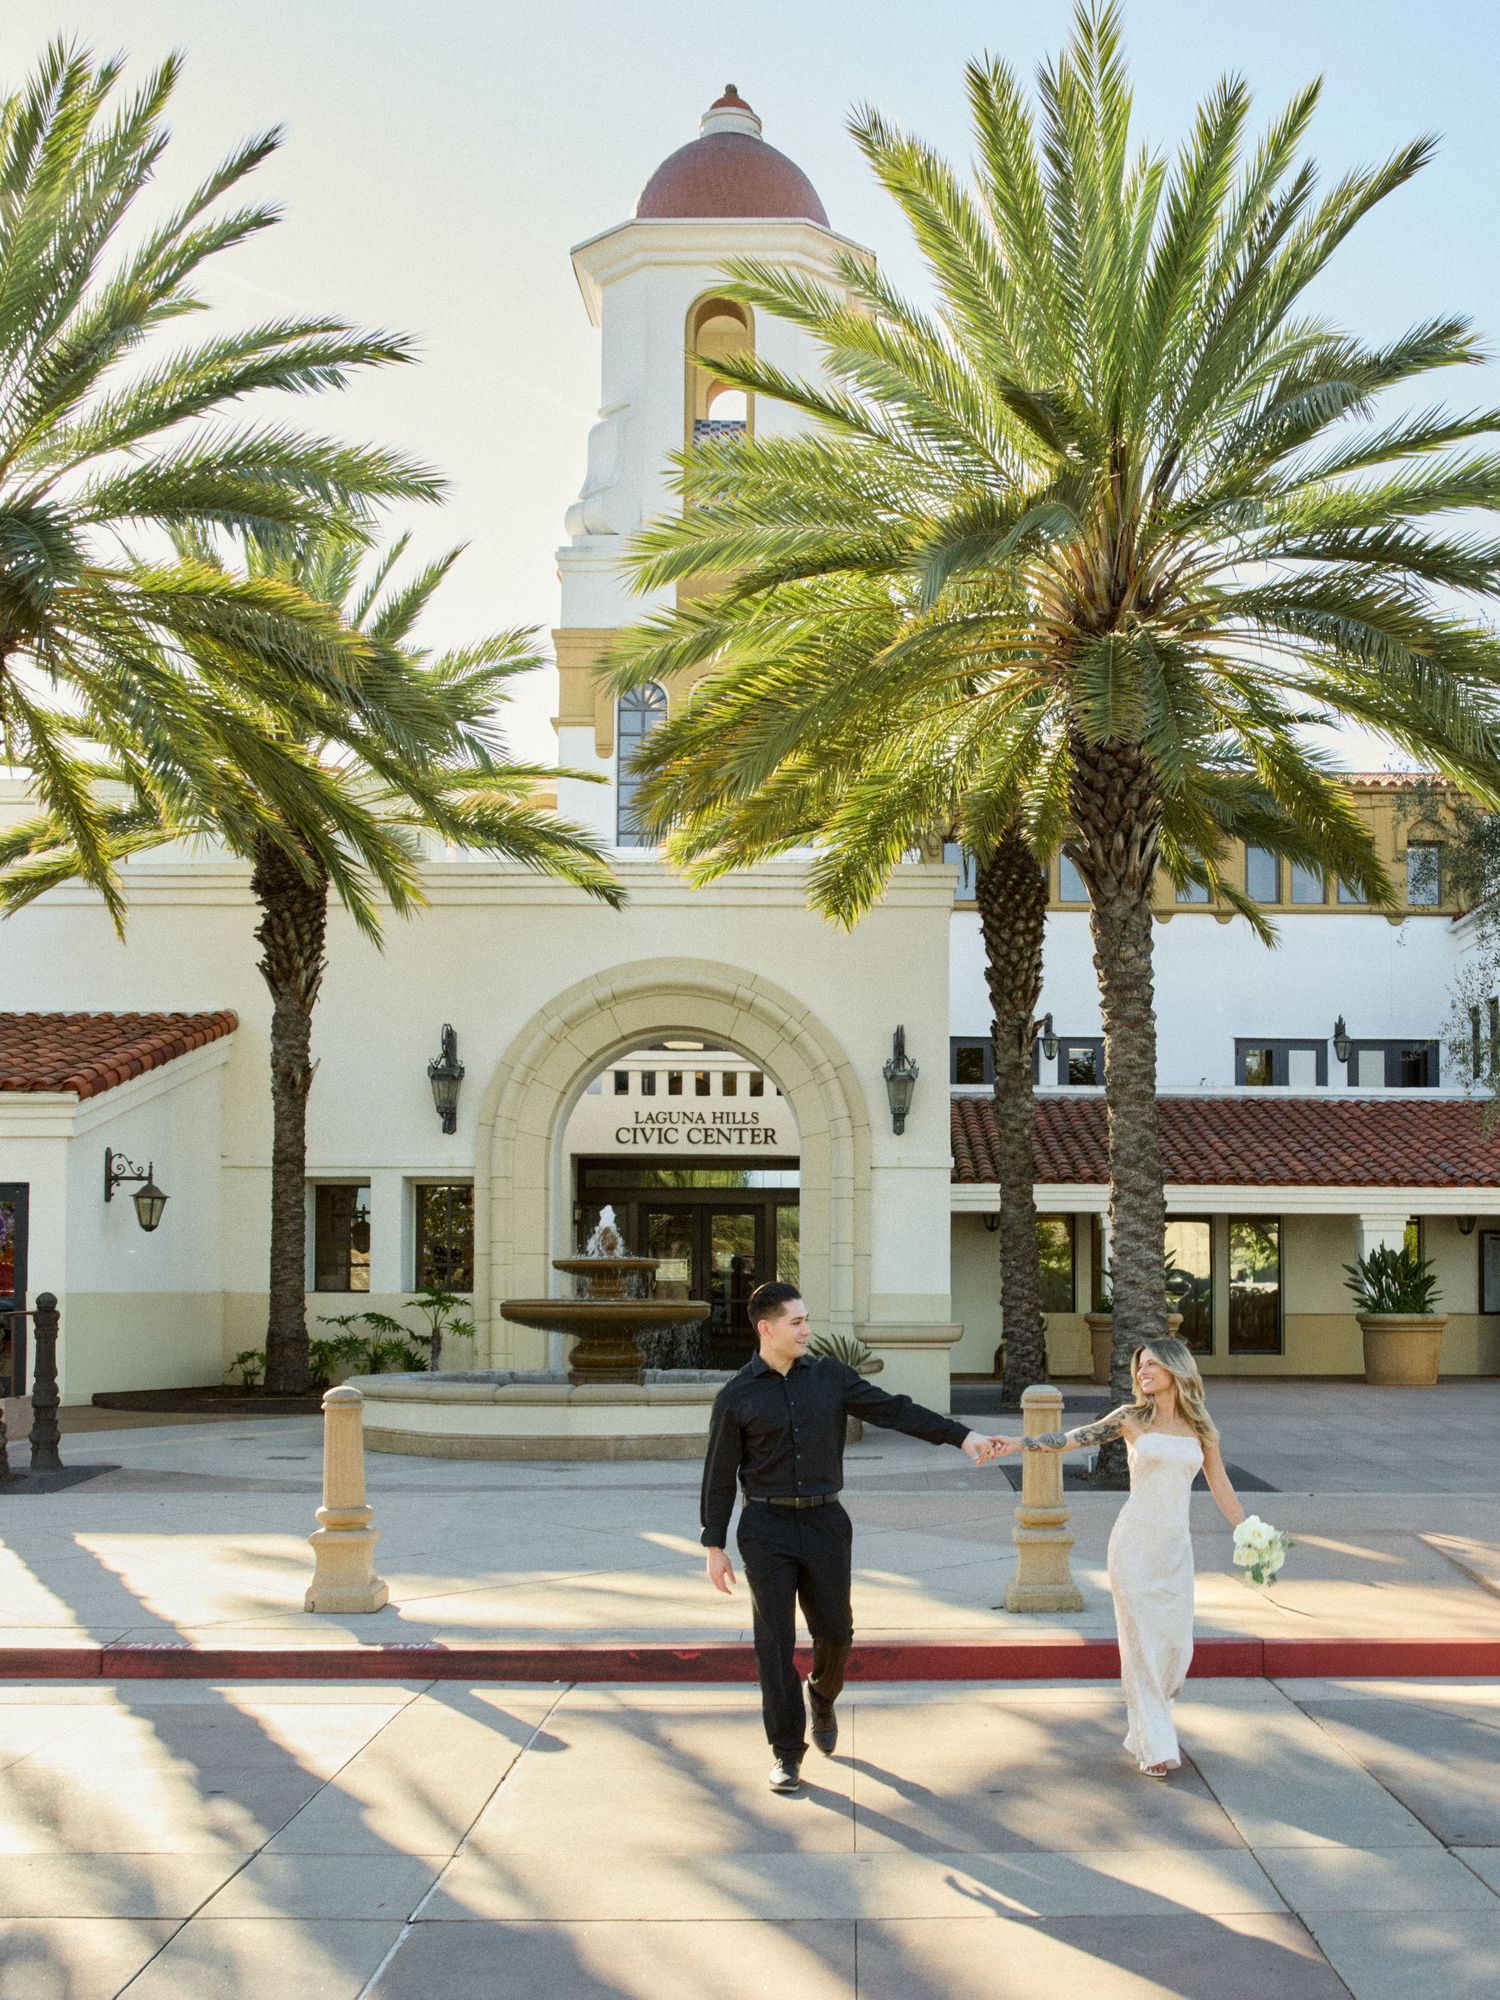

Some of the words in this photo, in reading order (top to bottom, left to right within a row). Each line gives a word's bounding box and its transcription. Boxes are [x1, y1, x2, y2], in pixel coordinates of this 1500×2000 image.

[634, 1111, 706, 1124] LAGUNA
[711, 1111, 759, 1124] HILLS
[615, 1127, 679, 1144] CIVIC
[686, 1127, 778, 1144] CENTER
